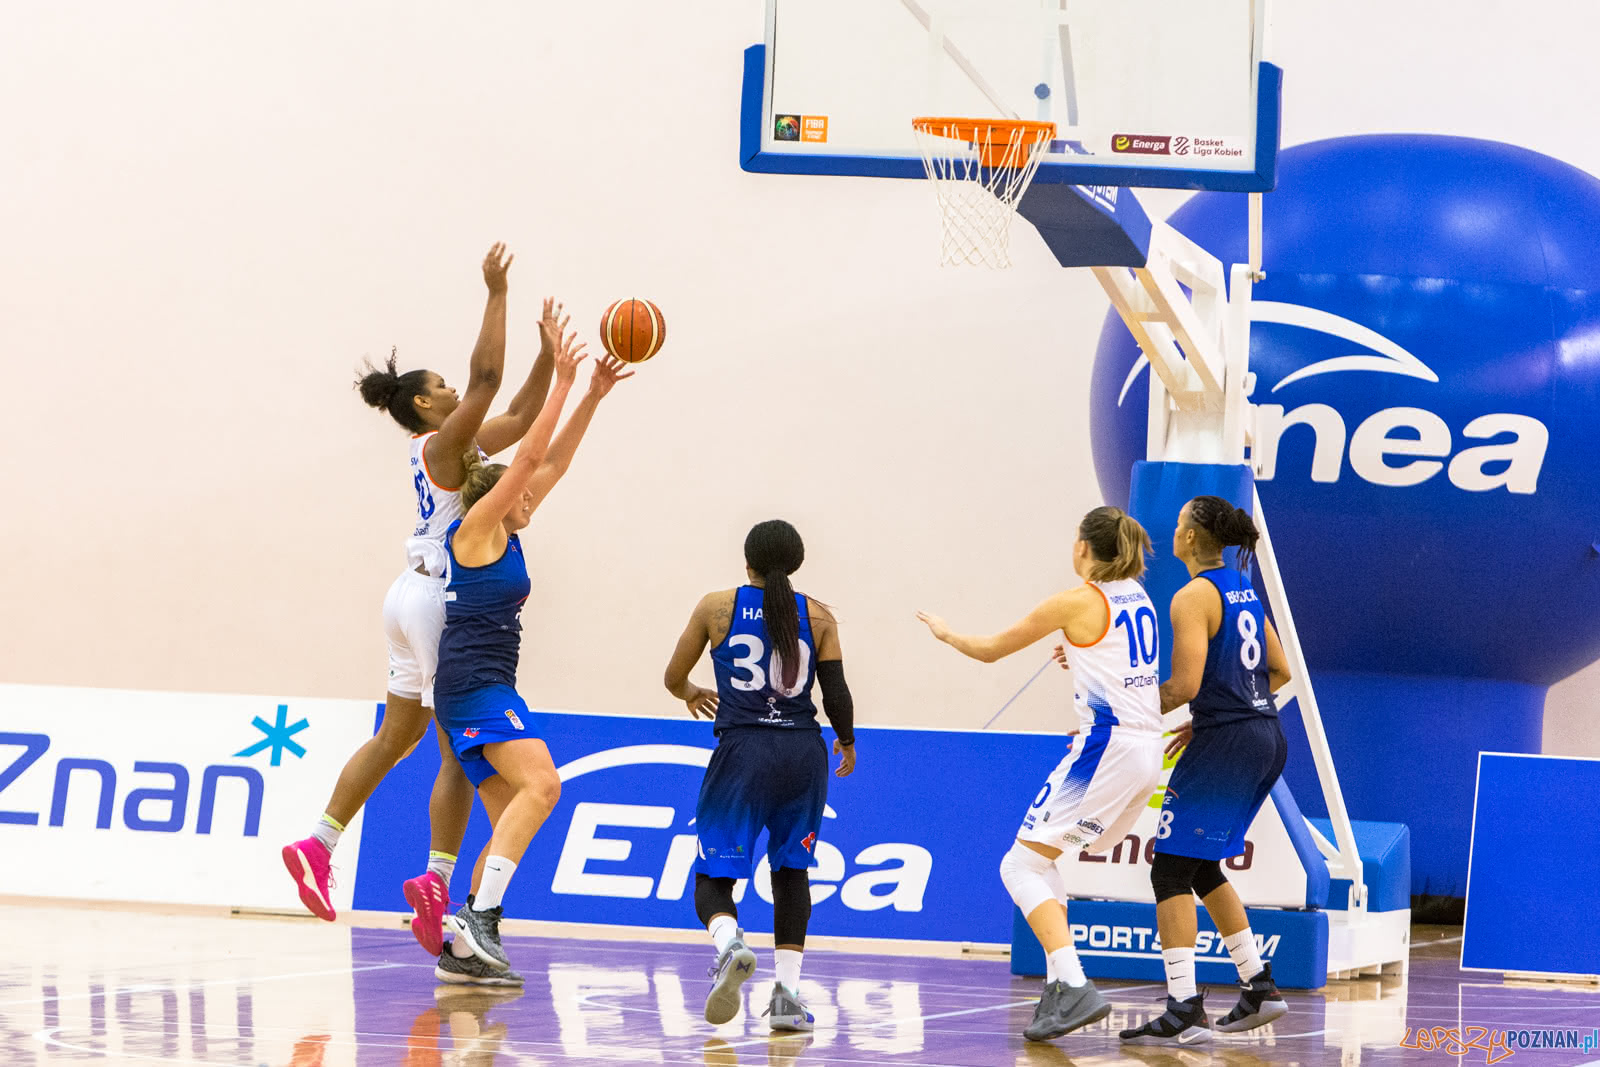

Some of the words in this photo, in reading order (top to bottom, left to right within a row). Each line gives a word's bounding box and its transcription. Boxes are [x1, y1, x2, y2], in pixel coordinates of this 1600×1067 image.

[1132, 139, 1166, 151] Energa
[1193, 147, 1212, 157] Liga
[1214, 148, 1243, 157] Kobiet
[1194, 138, 1224, 147] Basket
[1250, 400, 1549, 494] nea
[1115, 606, 1158, 668] 10
[1237, 609, 1261, 670] 8
[728, 633, 811, 698] 30
[1156, 810, 1174, 840] 8
